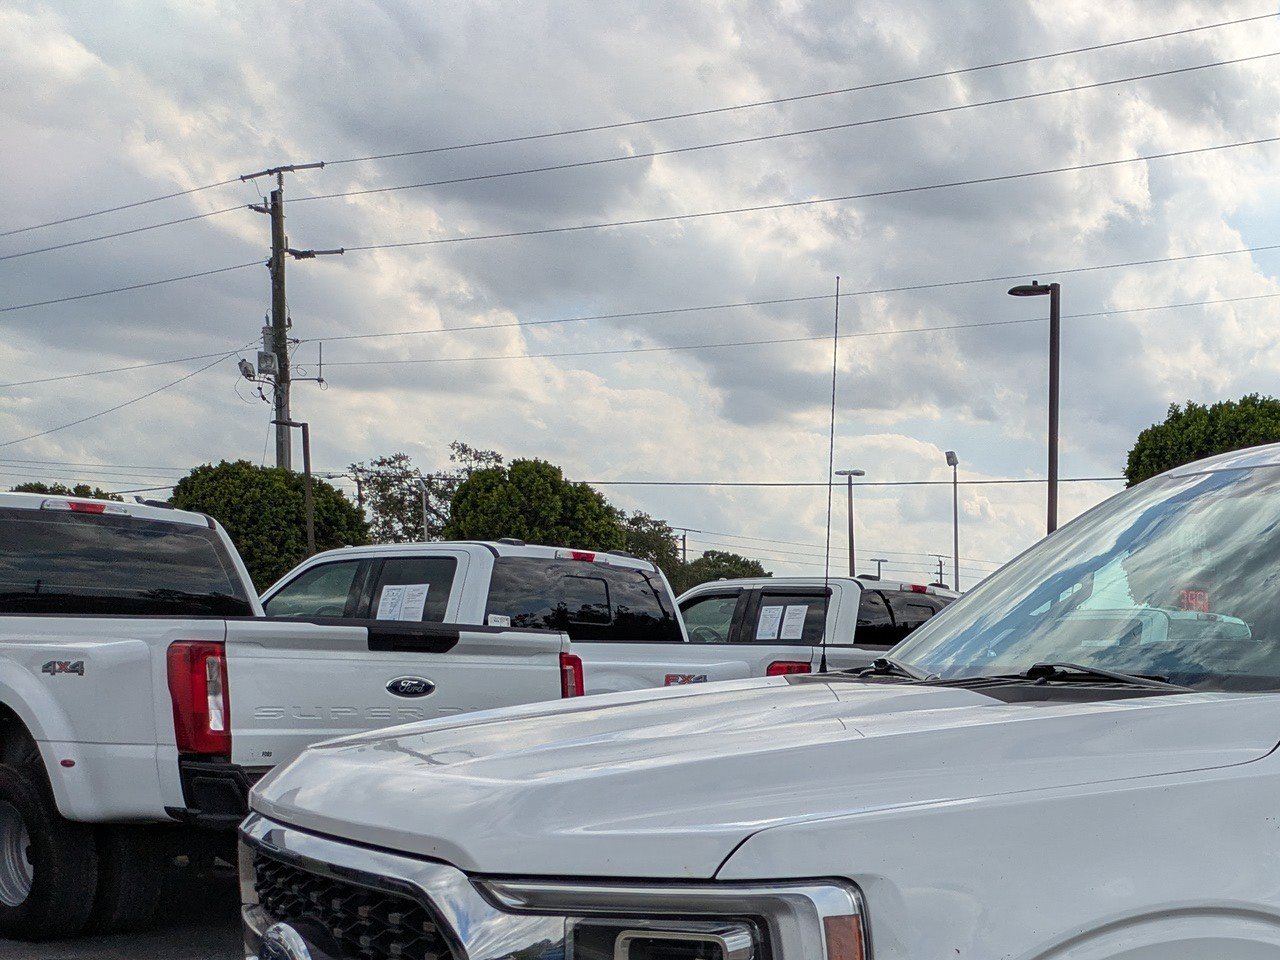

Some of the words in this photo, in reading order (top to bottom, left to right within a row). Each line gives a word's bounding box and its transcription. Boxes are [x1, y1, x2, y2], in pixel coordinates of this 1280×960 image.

[399, 680, 425, 693] Ford
[664, 674, 708, 686] FX4
[254, 706, 424, 720] SUPER
